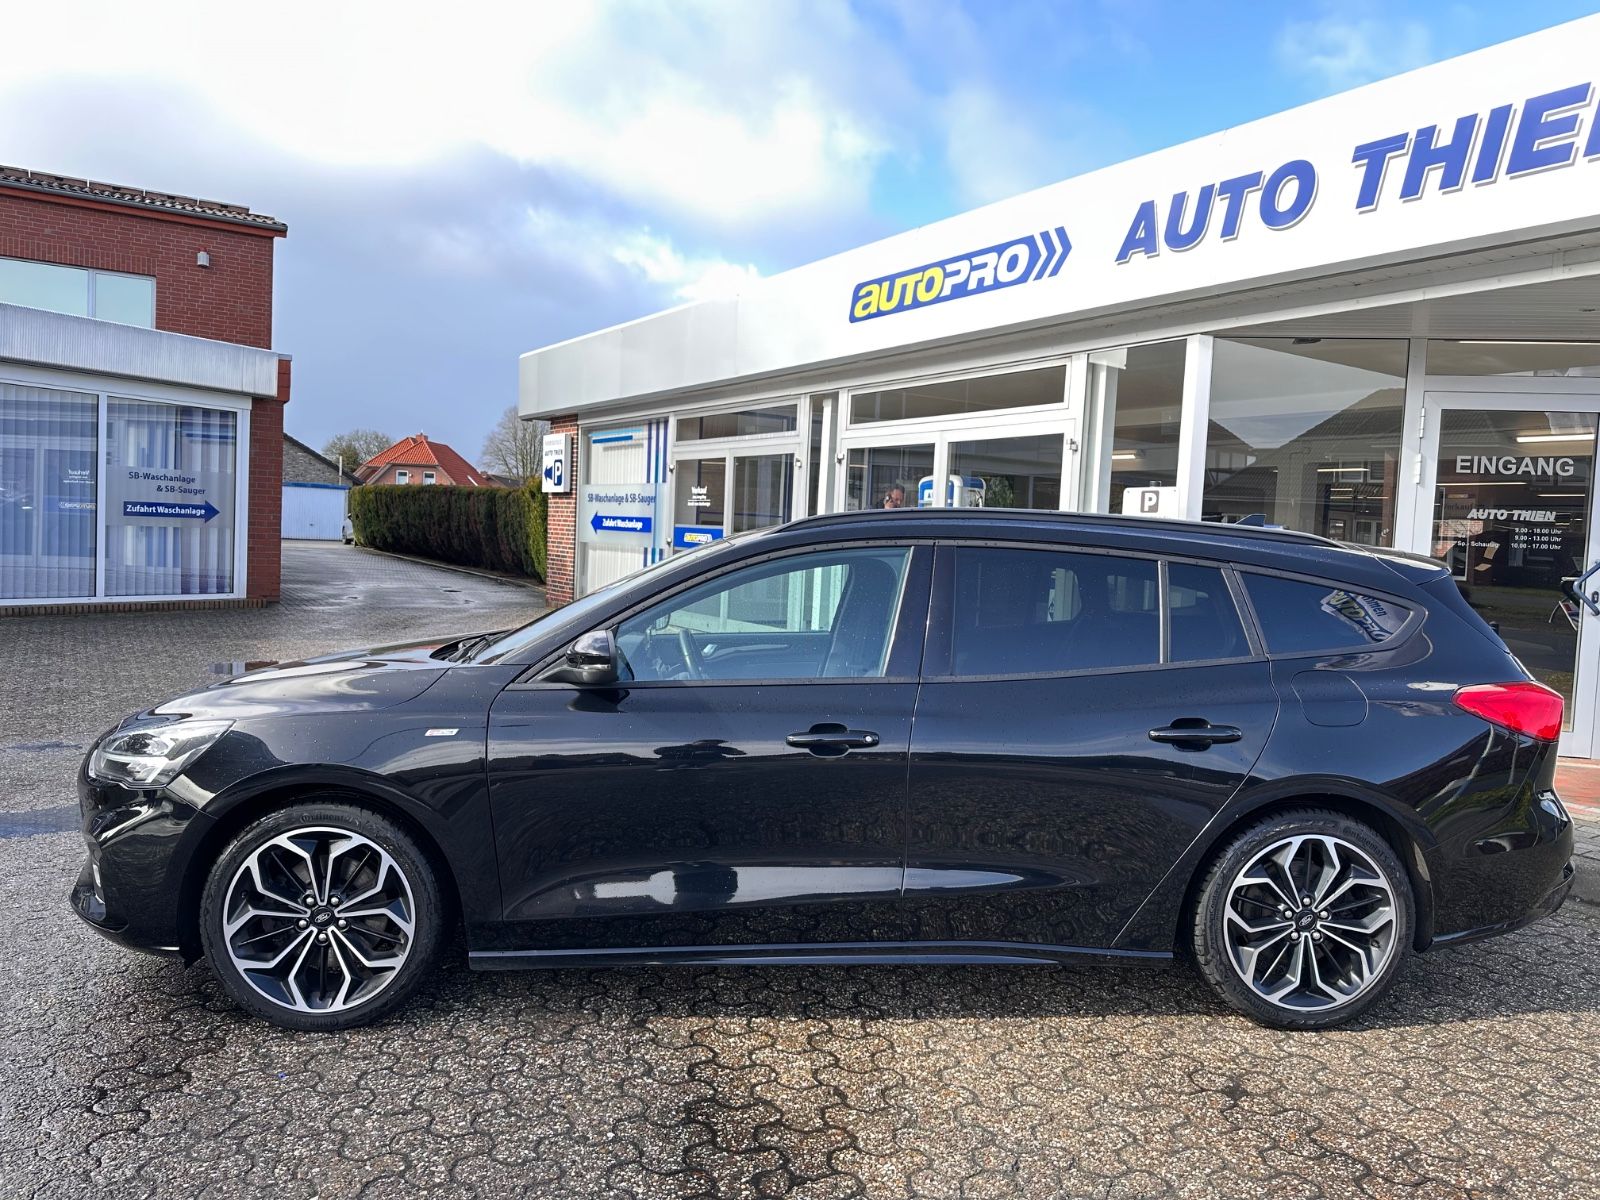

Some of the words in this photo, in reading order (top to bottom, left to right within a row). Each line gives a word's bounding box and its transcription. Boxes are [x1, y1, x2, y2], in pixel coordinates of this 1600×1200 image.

[1115, 159, 1318, 264] AUTO
[1455, 455, 1574, 477] EINGANG
[128, 471, 196, 484] SB-Waschanlage
[165, 485, 206, 495] SB-Sauger
[587, 493, 624, 506] SB-Waschanlage
[1143, 492, 1157, 512] P
[126, 504, 156, 513] Zufahrt
[157, 505, 205, 516] Waschanlage
[1467, 508, 1508, 520] AUTO
[1512, 509, 1557, 522] THIEN
